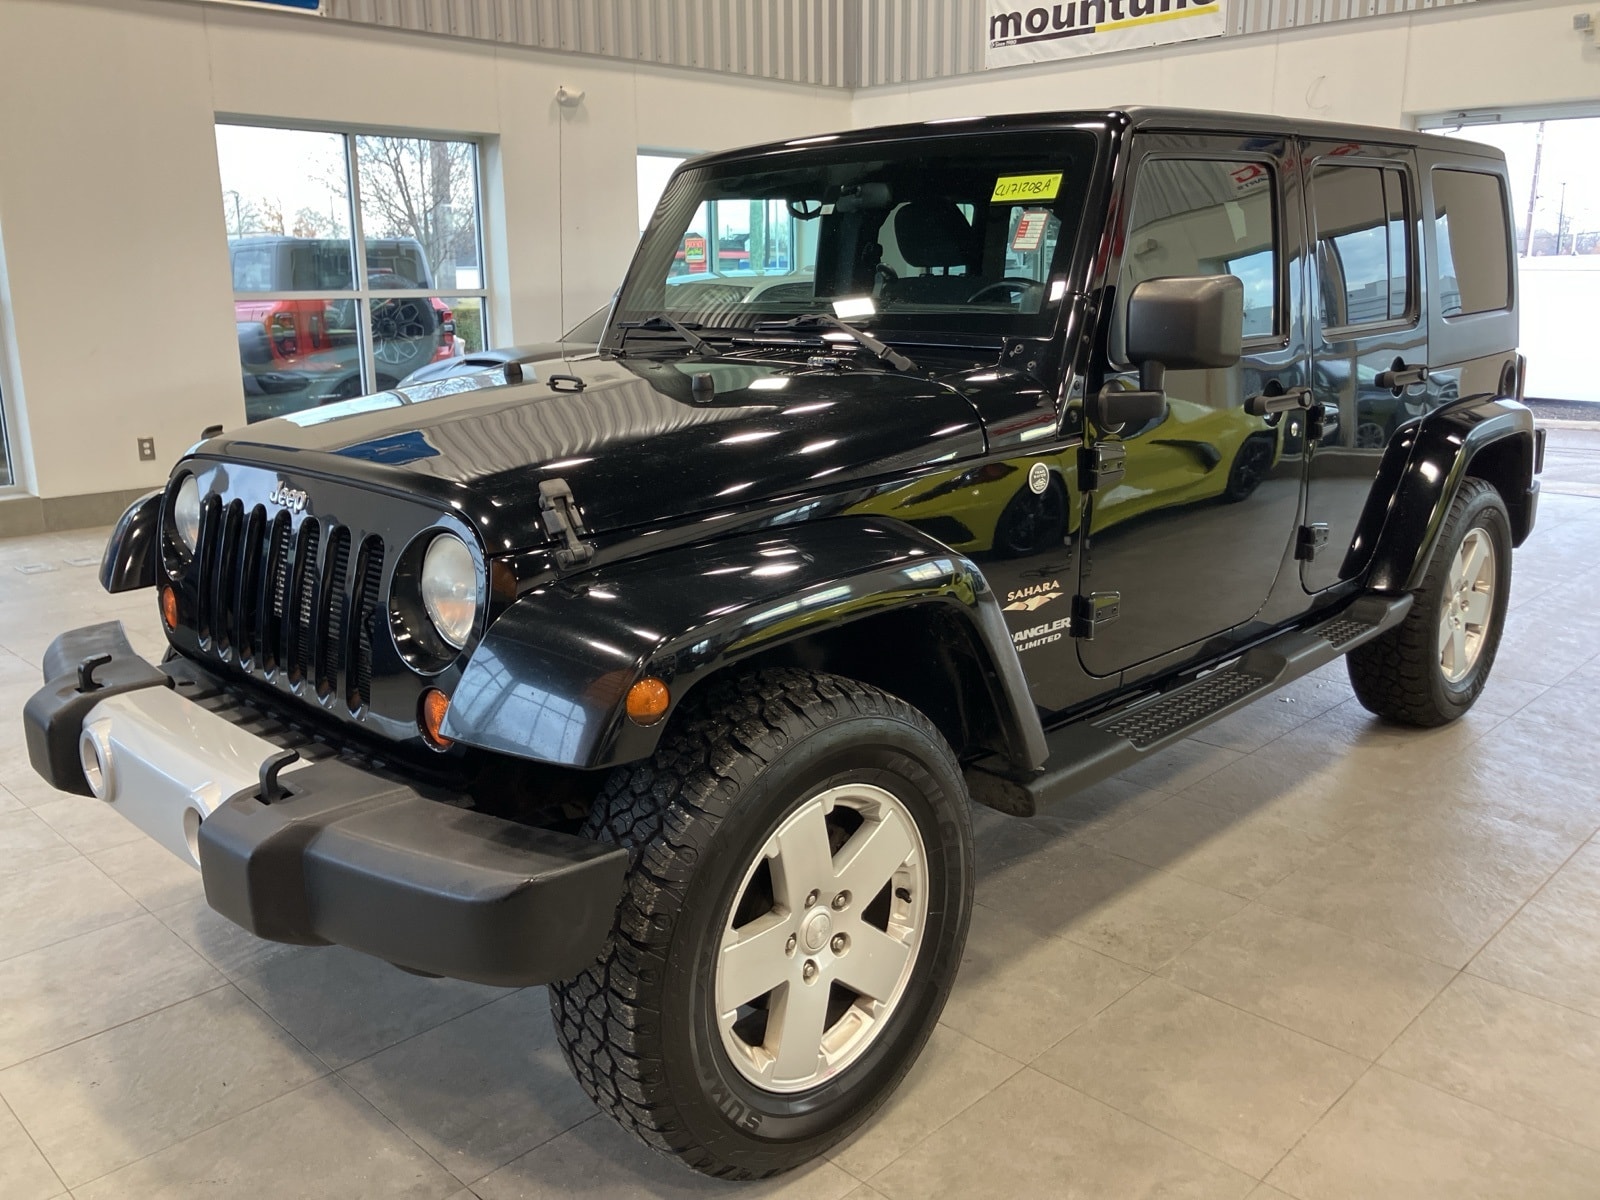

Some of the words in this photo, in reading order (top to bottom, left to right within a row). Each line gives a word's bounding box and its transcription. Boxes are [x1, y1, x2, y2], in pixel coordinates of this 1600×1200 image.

[990, 0, 1215, 40] mountu
[270, 481, 307, 514] Jeep
[1008, 579, 1061, 601] SAHARA
[1011, 617, 1072, 643] ANGLER
